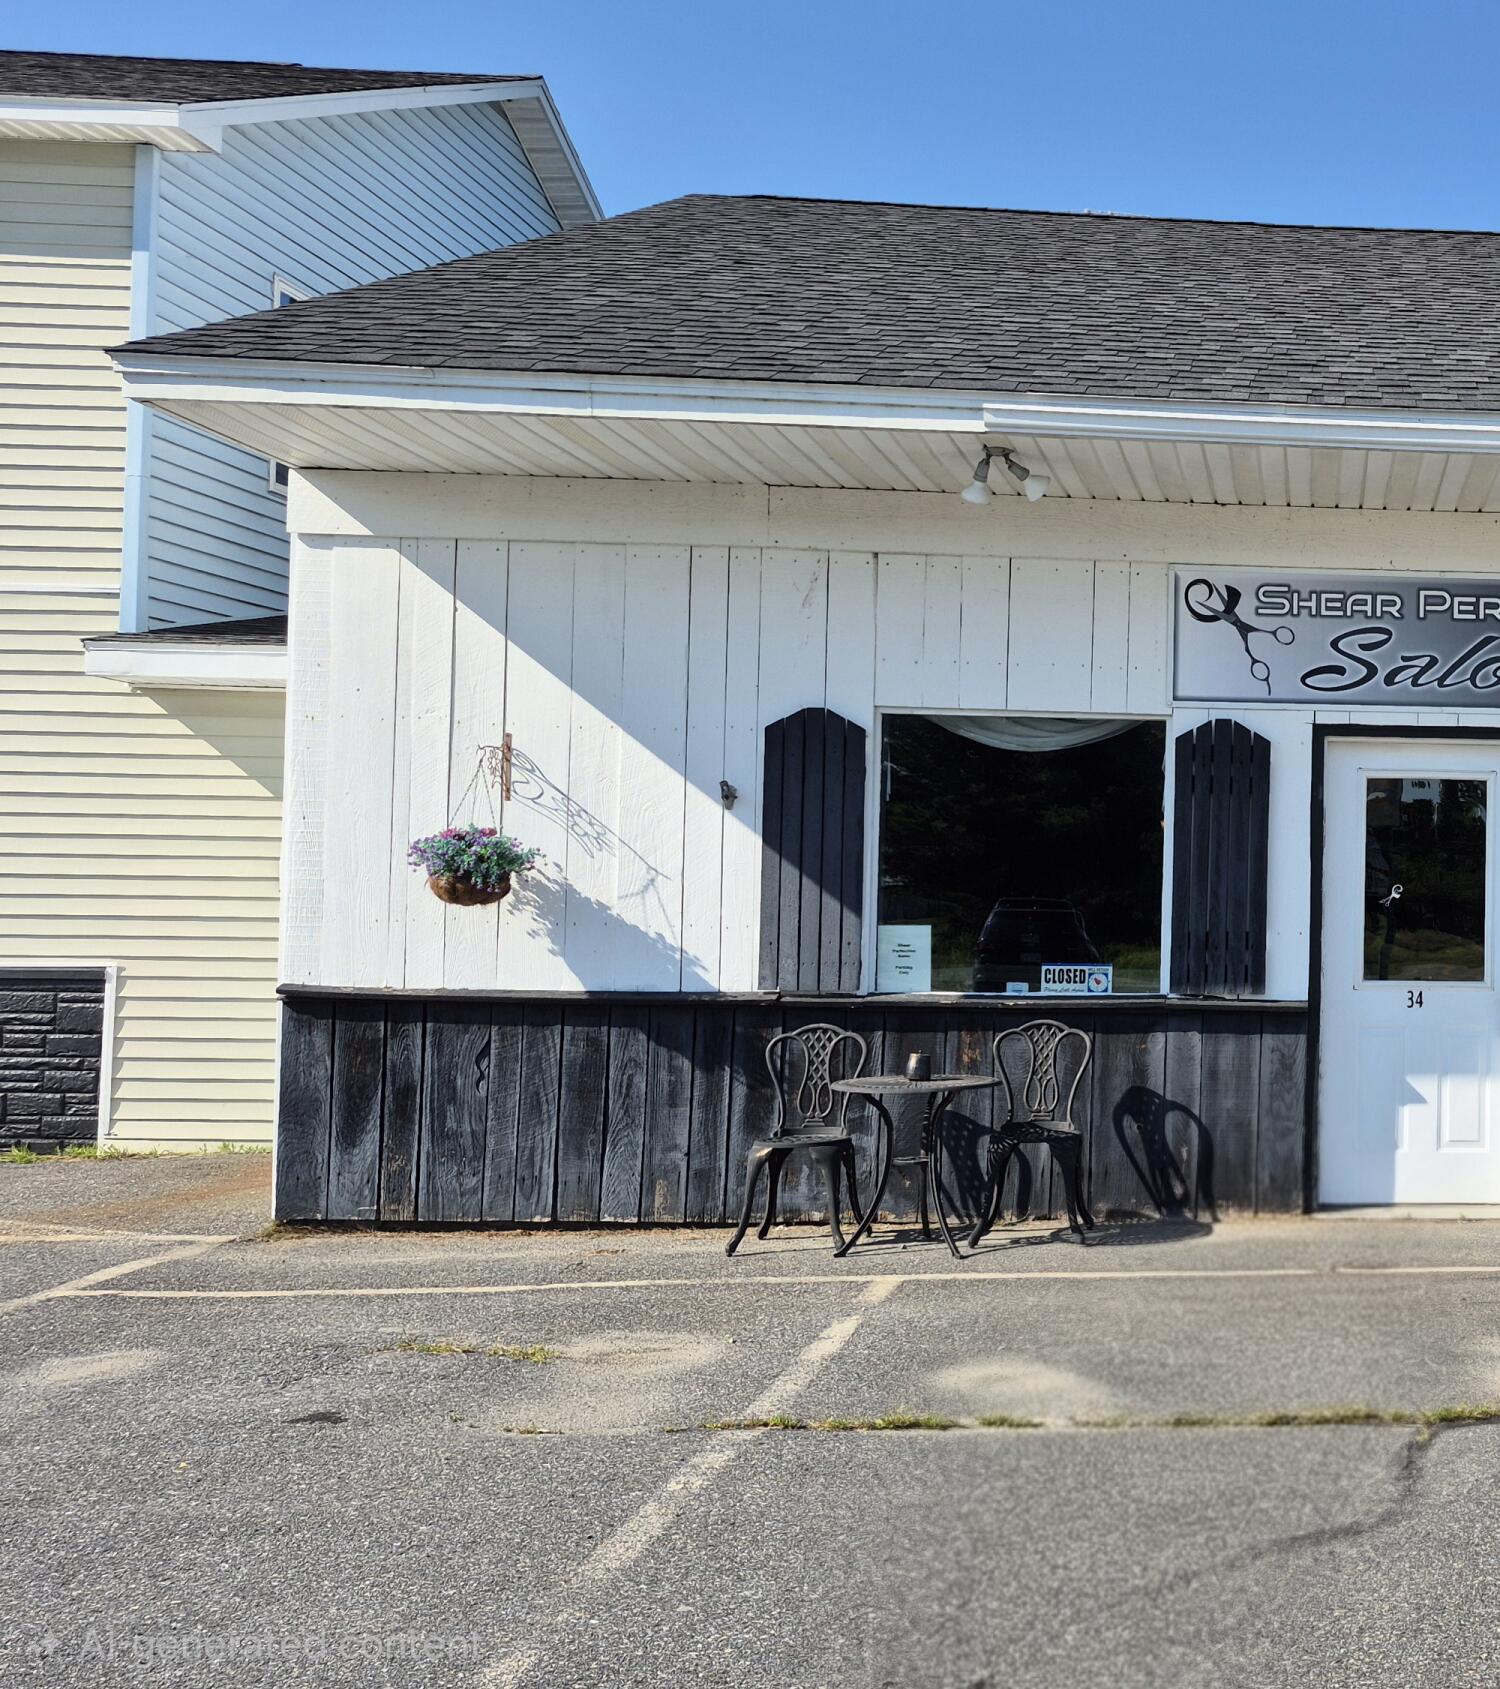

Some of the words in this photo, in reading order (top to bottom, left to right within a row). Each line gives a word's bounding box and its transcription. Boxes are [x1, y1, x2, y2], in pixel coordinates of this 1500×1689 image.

[1256, 584, 1401, 619] SHEAR
[1044, 968, 1087, 984] CLOSED
[1406, 990, 1424, 1009] 34
